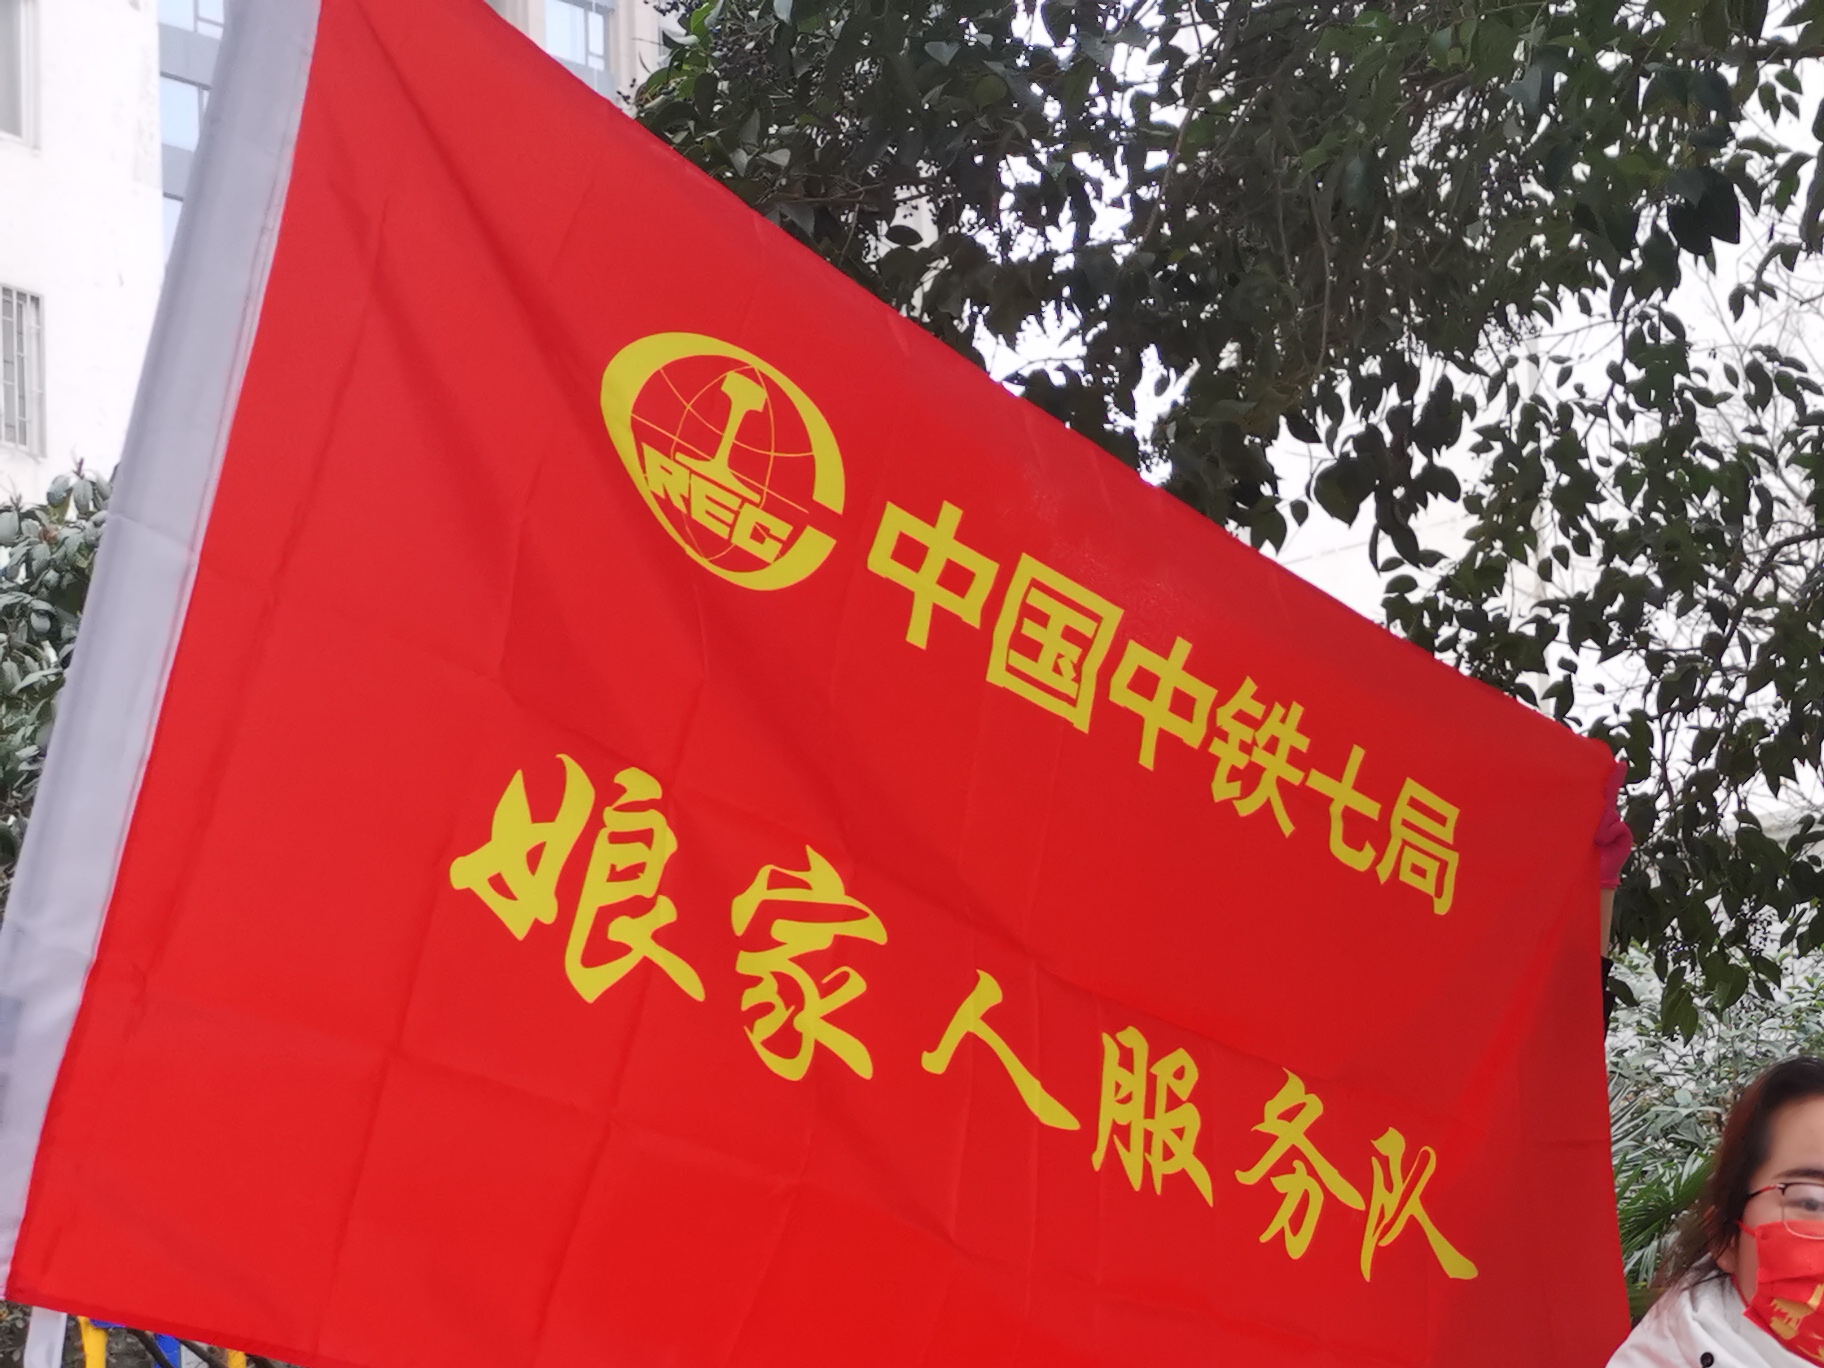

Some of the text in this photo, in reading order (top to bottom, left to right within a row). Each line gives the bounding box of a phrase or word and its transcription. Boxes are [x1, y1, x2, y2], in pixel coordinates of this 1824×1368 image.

[866, 500, 1461, 916] 中国中铁七局
[449, 753, 1478, 1282] 娘家人服务队
